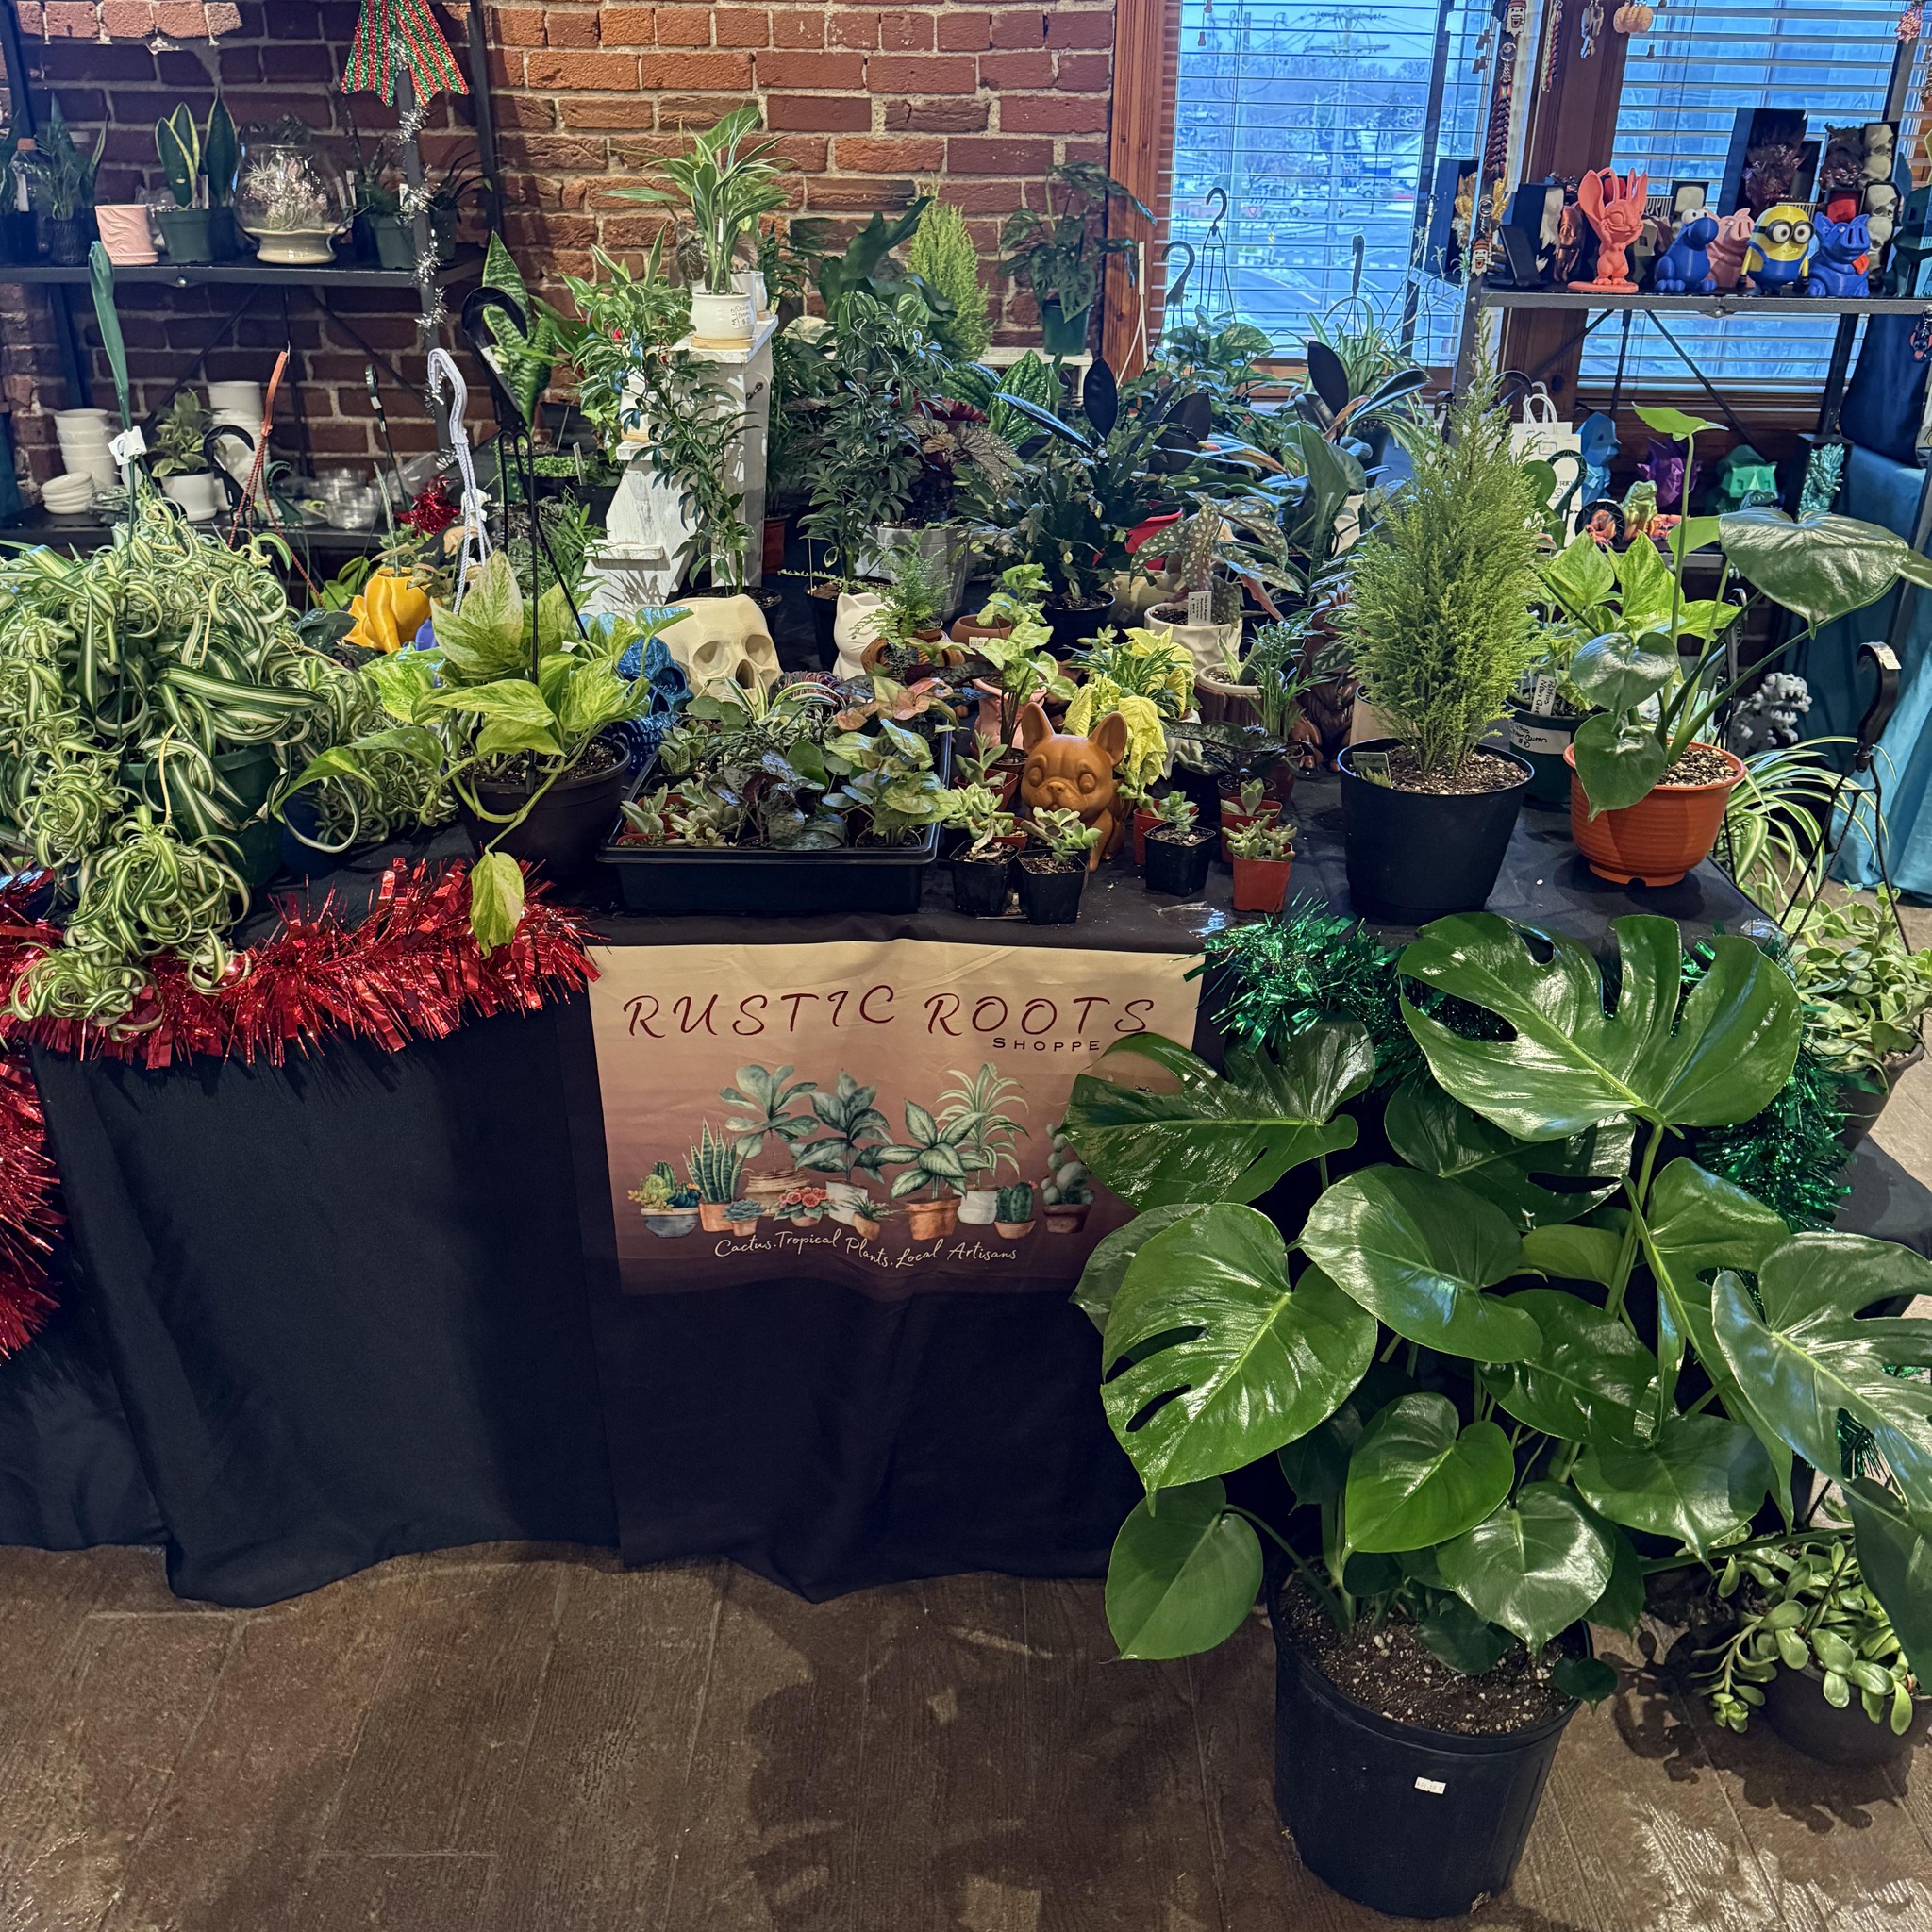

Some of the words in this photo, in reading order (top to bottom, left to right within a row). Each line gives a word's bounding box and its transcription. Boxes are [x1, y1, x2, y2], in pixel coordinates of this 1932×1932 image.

[623, 985, 895, 1039] RUSTIC
[924, 992, 1155, 1037] ROOTS
[993, 1038, 1101, 1052] SHOPPE
[946, 1241, 1017, 1261] Artisans
